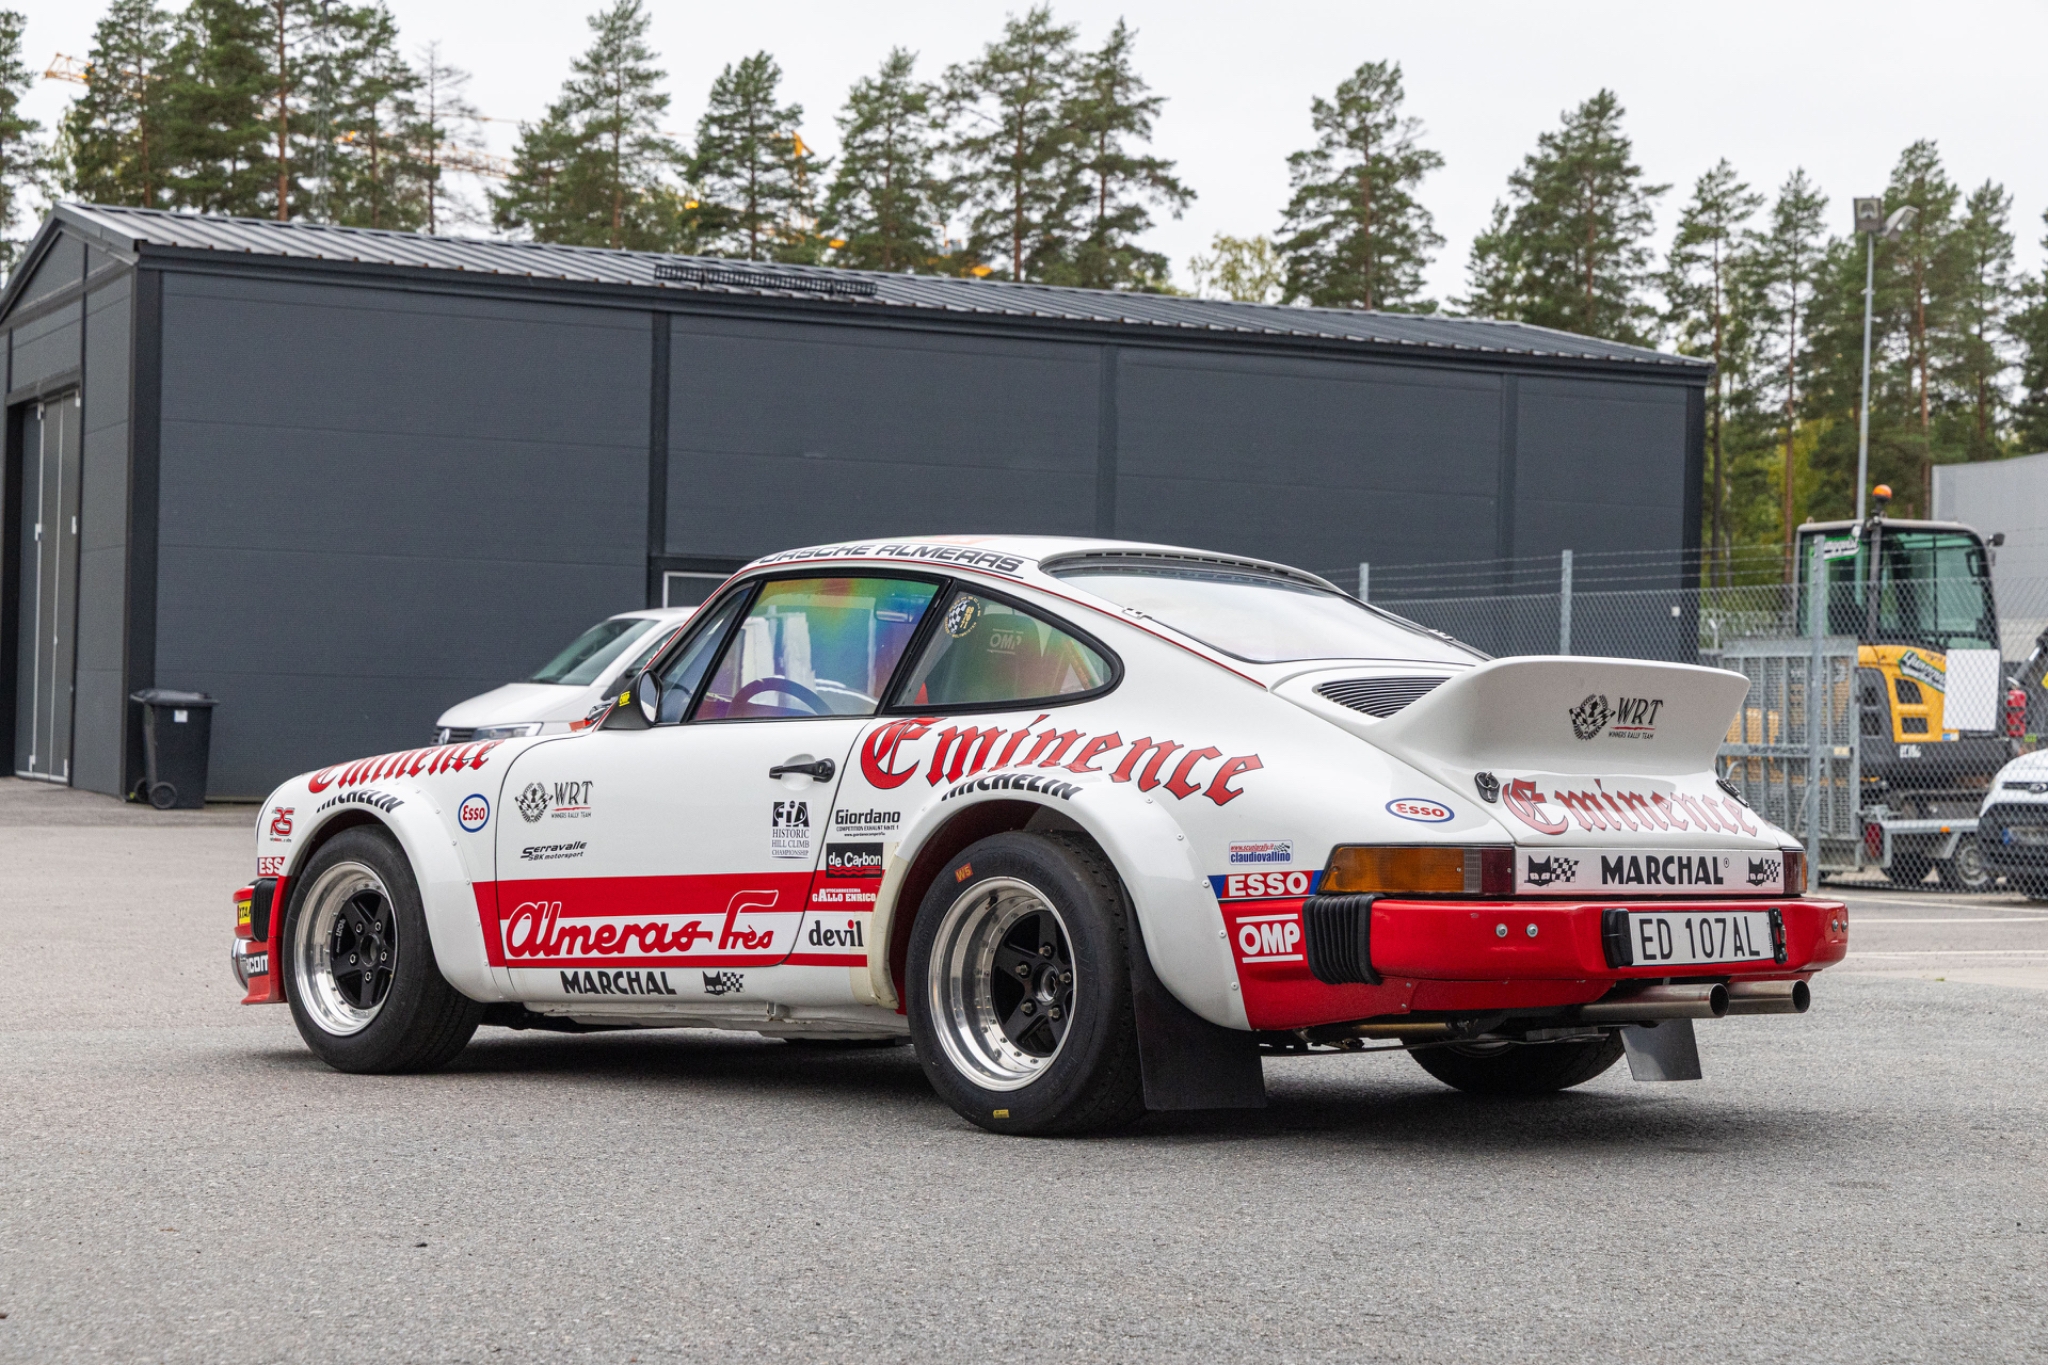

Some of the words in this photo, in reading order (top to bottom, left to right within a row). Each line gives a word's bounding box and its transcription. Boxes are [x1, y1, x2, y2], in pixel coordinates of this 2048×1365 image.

[875, 544, 1025, 572] ALMERAS
[1617, 697, 1664, 725] WRT
[860, 713, 1264, 807] Eminence
[554, 780, 594, 806] WRT
[835, 808, 901, 825] Giordano
[1502, 777, 1757, 838] Eminence
[771, 839, 787, 848] HILL
[787, 840, 810, 849] CLIMB
[772, 828, 810, 839] HISTORIC
[520, 841, 588, 859] Serravalle
[544, 851, 584, 860] motorsport
[828, 853, 842, 868] de
[844, 852, 882, 868] Carbon
[1230, 851, 1291, 863] claudiovallino
[259, 859, 282, 875] ESS
[1601, 855, 1724, 886] MARCHAL
[1228, 872, 1309, 897] ESSO
[808, 919, 864, 947] devil
[1239, 922, 1300, 955] OMP
[1639, 918, 1673, 960] ED
[1685, 916, 1760, 959] 107AL
[560, 971, 677, 995] MARCHAL
